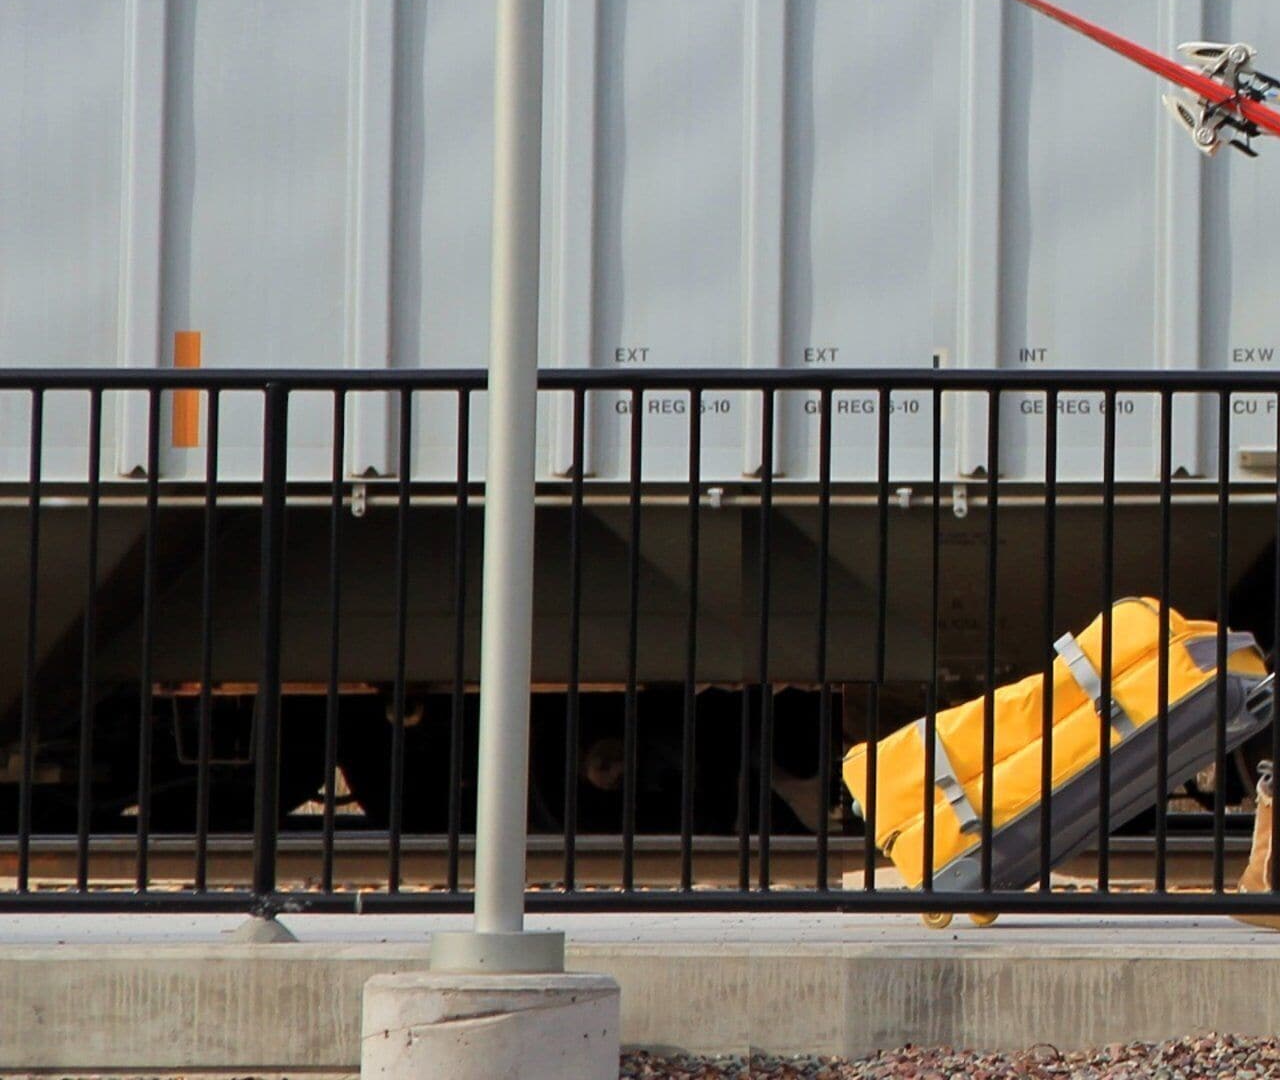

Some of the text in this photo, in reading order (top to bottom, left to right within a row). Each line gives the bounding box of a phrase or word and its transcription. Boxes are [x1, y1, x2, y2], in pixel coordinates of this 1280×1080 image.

[615, 347, 650, 362] EXT
[804, 347, 839, 362] EXT
[1019, 348, 1047, 362] INT
[648, 399, 686, 414] REG
[838, 399, 875, 414] REG
[1020, 399, 1044, 414] GE
[1233, 399, 1257, 414] CU
